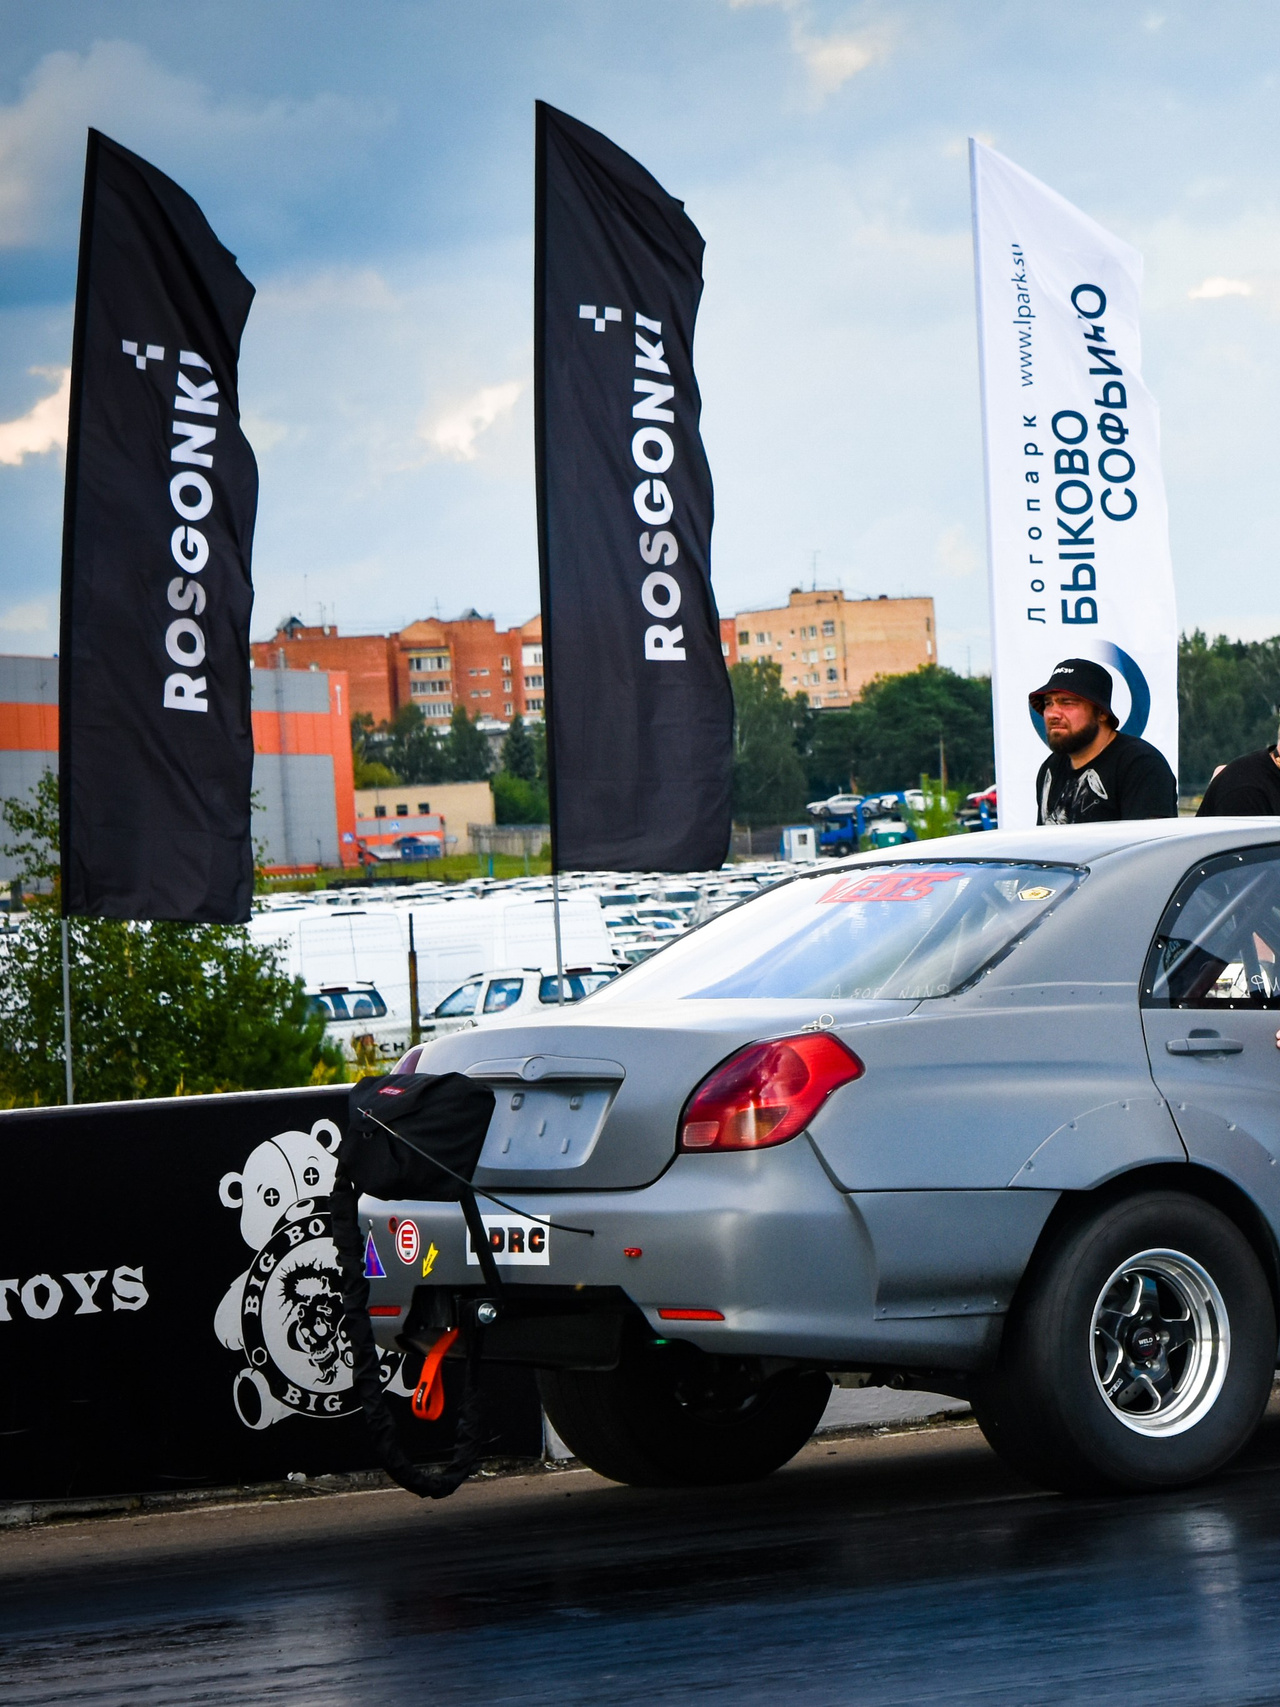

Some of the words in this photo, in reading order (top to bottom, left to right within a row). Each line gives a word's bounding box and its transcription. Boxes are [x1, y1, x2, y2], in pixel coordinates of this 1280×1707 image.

[1010, 243, 1037, 387] www.lpark.su
[1070, 283, 1138, 522] СОФЬИНО
[163, 349, 220, 713] ROSGONKI
[632, 311, 687, 662] ROSGONKI
[1023, 414, 1046, 625] Логопарк
[1051, 408, 1099, 625] БЫКОВО
[243, 1251, 277, 1317] BIG
[469, 1226, 546, 1254] DRC
[282, 1383, 343, 1412] BIG
[1138, 1337, 1154, 1345] WELD
